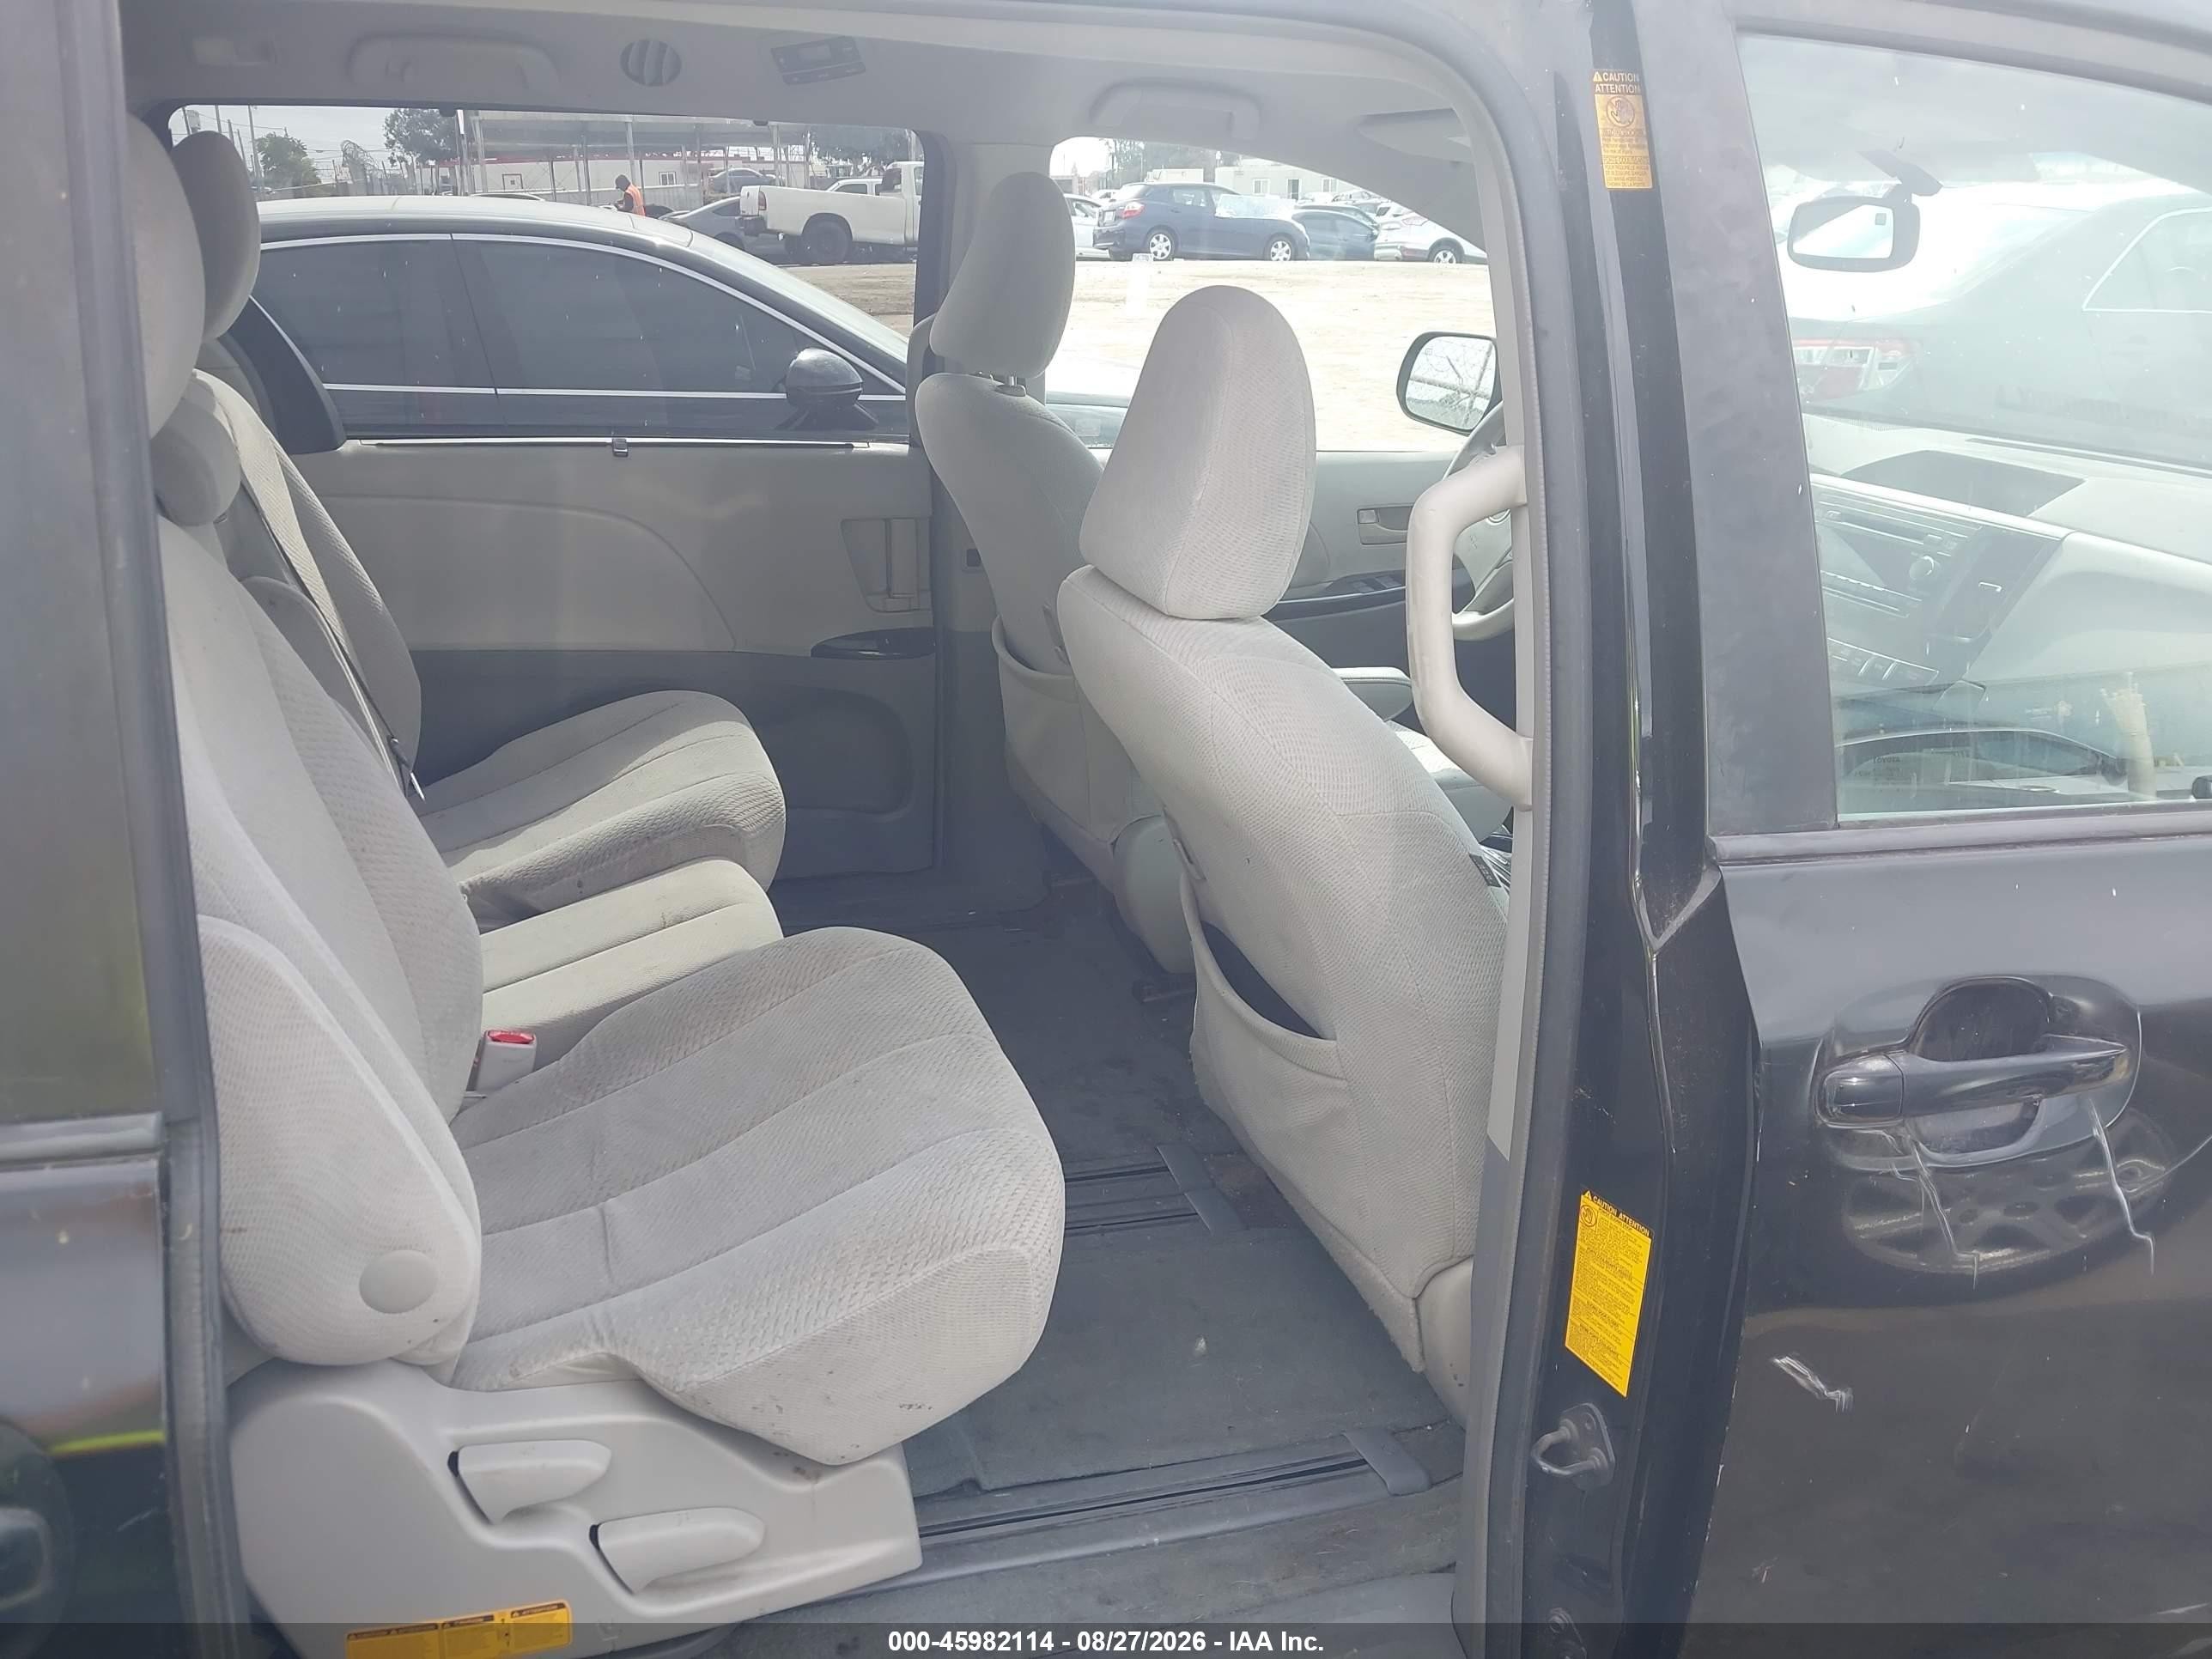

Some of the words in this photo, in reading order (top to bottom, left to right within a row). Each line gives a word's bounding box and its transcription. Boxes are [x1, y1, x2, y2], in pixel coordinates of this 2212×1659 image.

[1602, 71, 1639, 82] CAUTION
[1595, 83, 1641, 94] ATTENTION
[1593, 1195, 1617, 1216] CAUTION
[1618, 1212, 1650, 1237] ATTENTION
